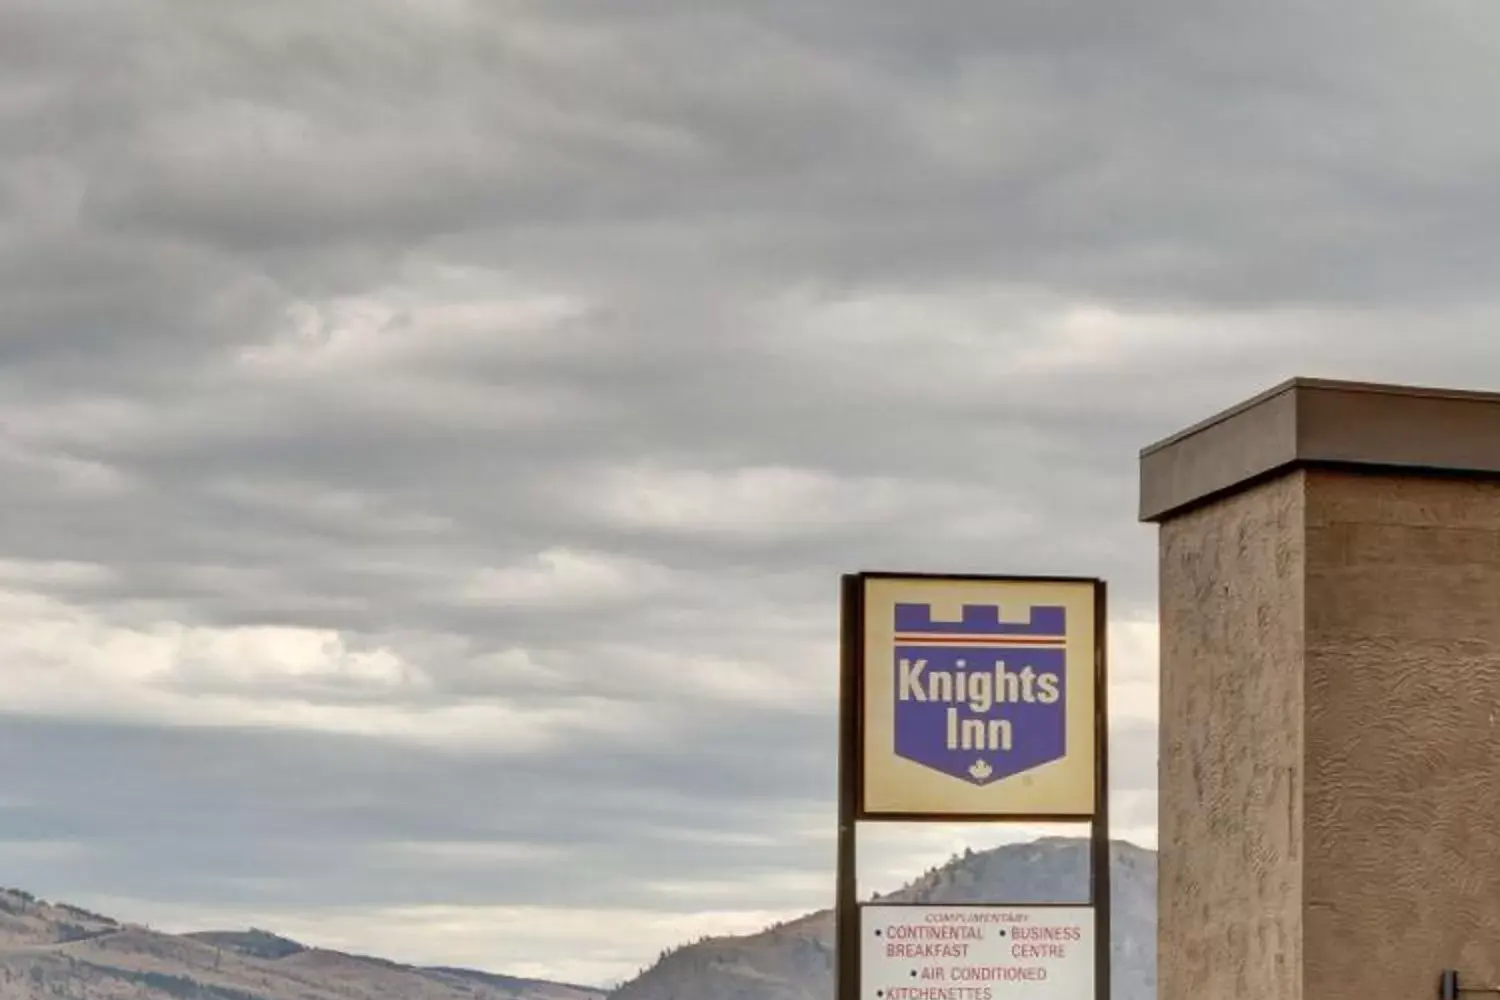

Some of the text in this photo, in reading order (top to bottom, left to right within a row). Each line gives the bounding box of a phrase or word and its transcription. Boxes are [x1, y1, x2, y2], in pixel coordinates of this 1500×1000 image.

[899, 658, 1060, 713] Knights
[946, 707, 1012, 751] Inn
[886, 925, 984, 940] CONTINENTAL
[1011, 926, 1081, 941] BUSINESS
[886, 943, 969, 958] BREAKFAST
[1011, 943, 1066, 958] CENTRE
[921, 966, 1047, 981] AIR CONDITIONED
[886, 986, 992, 1000] KITCHENETTES
